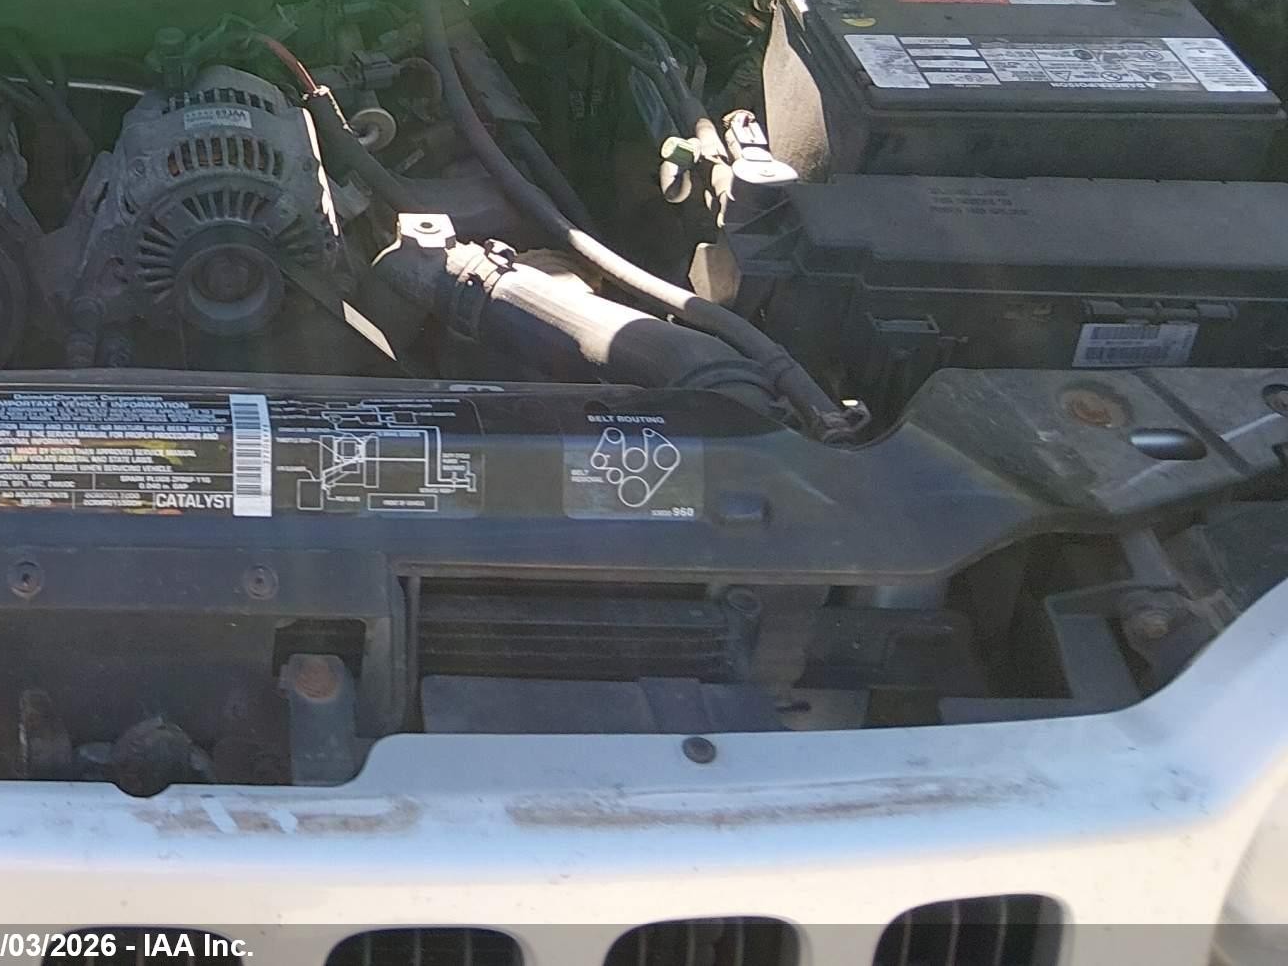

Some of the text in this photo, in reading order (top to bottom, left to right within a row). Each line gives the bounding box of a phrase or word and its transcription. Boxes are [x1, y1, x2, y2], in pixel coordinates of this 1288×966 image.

[61, 400, 108, 408] VEHICLE
[110, 401, 190, 409] INFORMATION
[586, 415, 665, 424] BELT ROUTING
[156, 493, 233, 509] CATALYST
